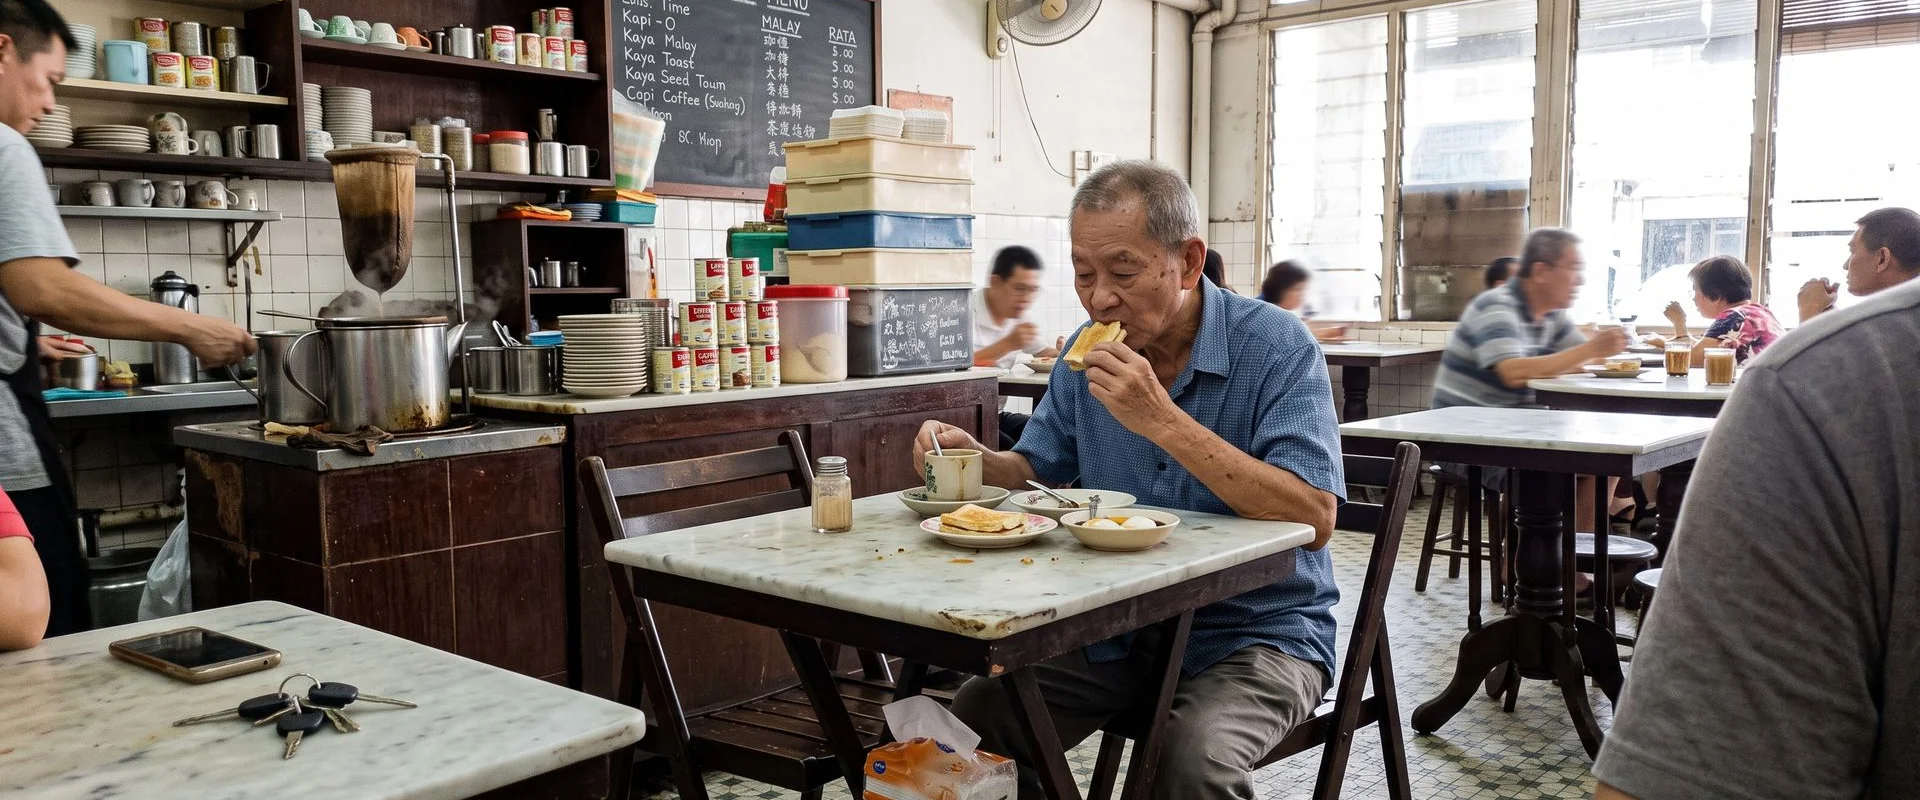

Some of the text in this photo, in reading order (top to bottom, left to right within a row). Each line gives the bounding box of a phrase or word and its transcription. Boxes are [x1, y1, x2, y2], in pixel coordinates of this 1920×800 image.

[766, 0, 808, 10] ENU
[622, 8, 651, 31] Kapi
[762, 14, 801, 35] MALAY
[623, 26, 697, 58] Kaya Malay
[828, 26, 857, 44] RATA
[624, 45, 695, 70] Kaya Toast
[625, 65, 656, 87] Kaya
[661, 69, 690, 87] Seed
[662, 89, 700, 106] Coffee
